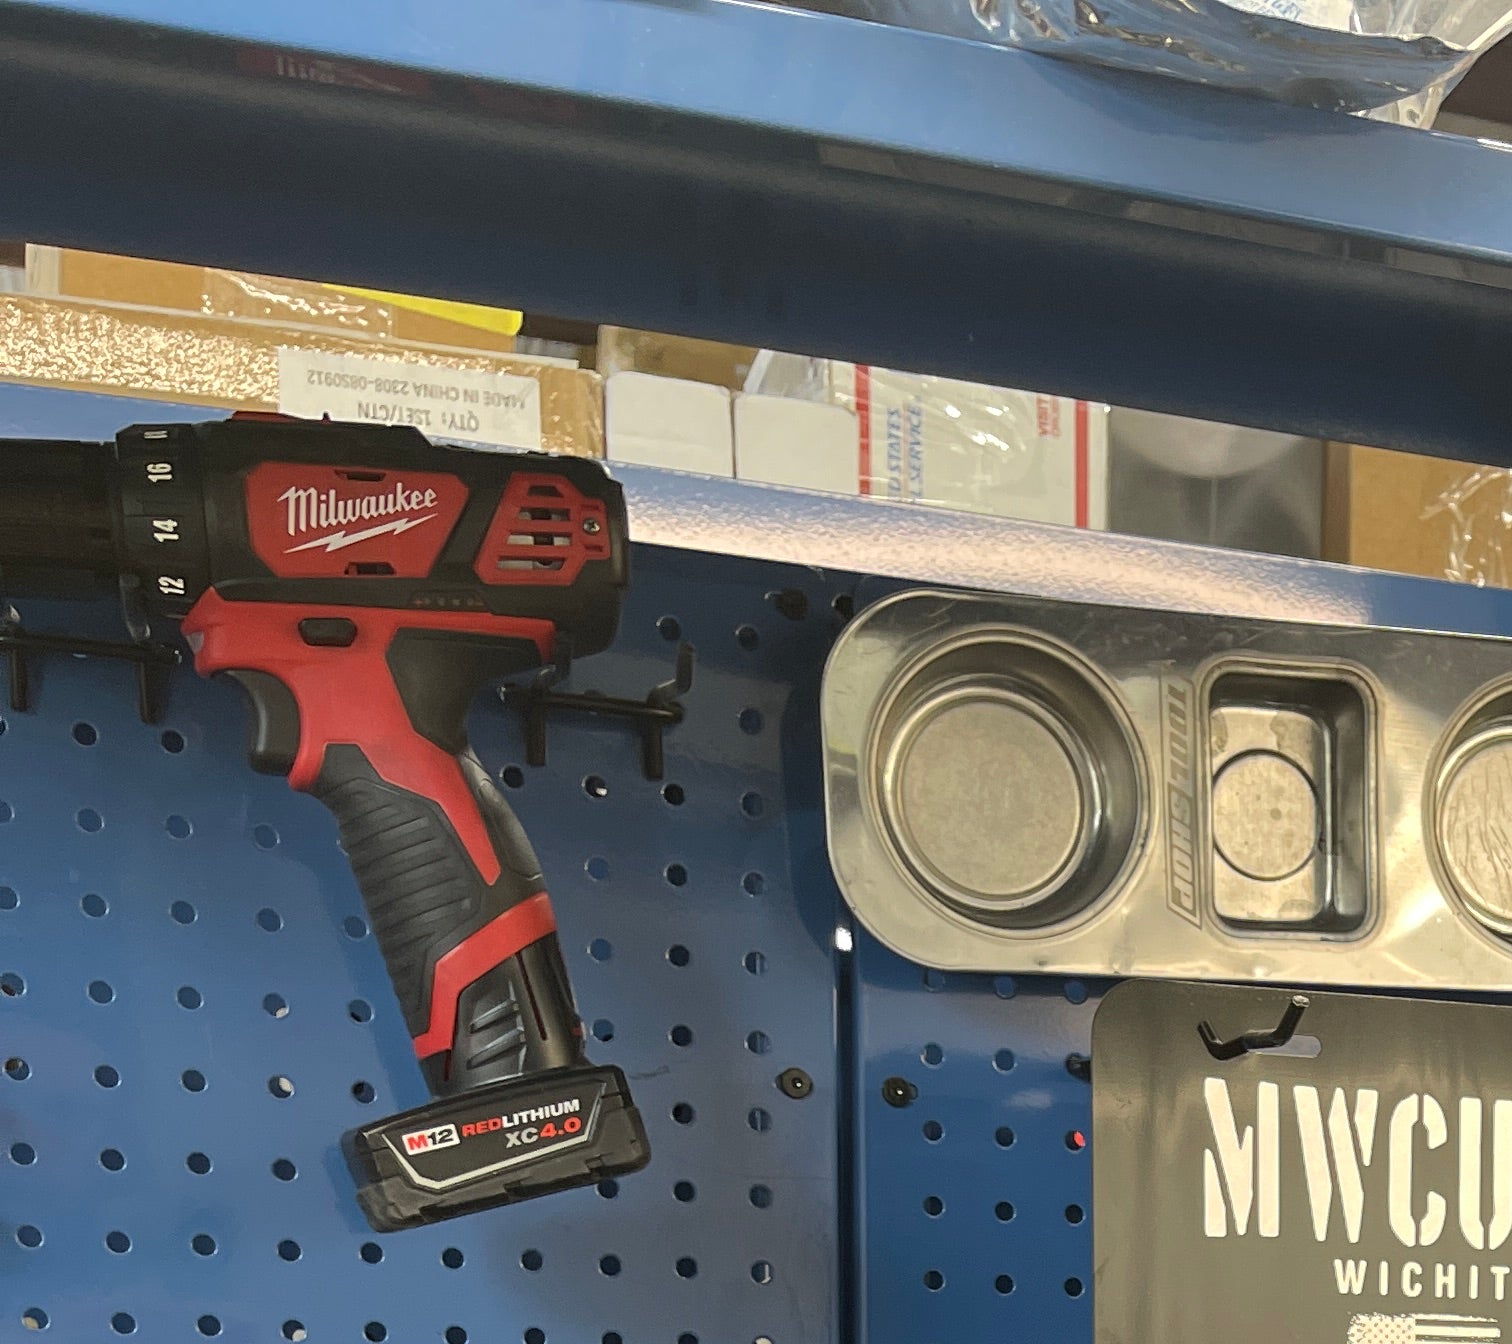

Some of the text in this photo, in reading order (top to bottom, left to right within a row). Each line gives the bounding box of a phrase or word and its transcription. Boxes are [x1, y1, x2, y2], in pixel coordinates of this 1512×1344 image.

[412, 381, 461, 401] CHINA
[462, 387, 480, 402] IN
[482, 390, 527, 410] MADE
[441, 409, 480, 433] QTY:
[908, 402, 923, 481] SERVICE
[146, 462, 173, 483] 16
[277, 482, 439, 537] Milwaukee
[152, 518, 180, 543] 14
[157, 576, 186, 595] 12
[406, 1099, 580, 1151] M12 REDLITHIUM
